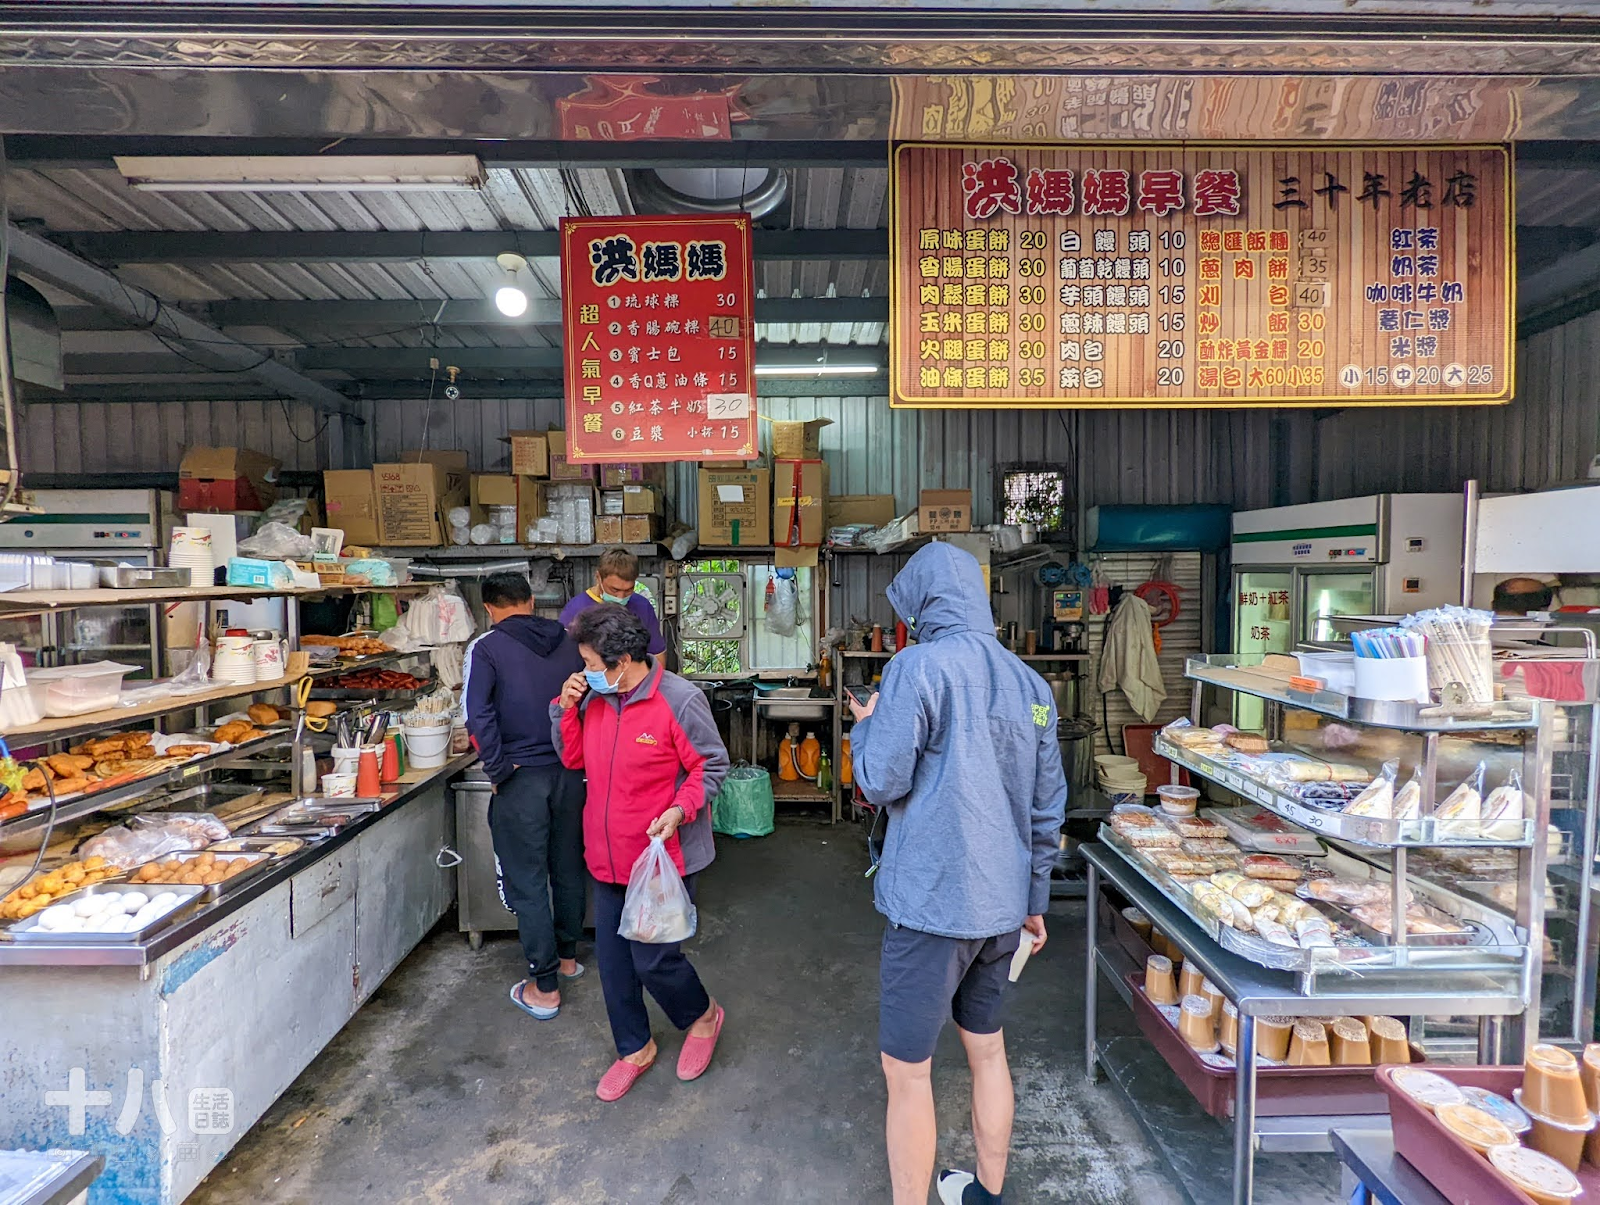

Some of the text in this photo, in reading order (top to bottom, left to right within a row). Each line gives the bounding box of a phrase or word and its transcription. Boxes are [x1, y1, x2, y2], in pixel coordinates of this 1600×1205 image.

[963, 157, 1478, 218] 洪媽媽早餐 三十年老店
[919, 228, 1046, 252] 原味蛋餅 20
[1060, 230, 1185, 253] 白饅頭 10
[1307, 231, 1326, 242] 40
[1392, 228, 1438, 250] 紅茶
[590, 236, 725, 286] 洪媽媽
[919, 256, 1046, 279] 香腸蛋餅 30
[1060, 258, 1185, 280] 葡萄乾饅頭 10
[1310, 259, 1328, 274] 35
[1392, 256, 1438, 277] 奶茶
[716, 293, 736, 307] 30
[919, 284, 1046, 306] 肉鬆蛋餅 30
[1060, 285, 1185, 307] 芋頭饅頭 15
[1200, 285, 1318, 306] 刈包 40
[1366, 283, 1464, 303] 咖啡牛奶
[710, 318, 733, 336] 40
[919, 312, 1046, 334] 玉米蛋餅 30
[1159, 314, 1185, 331] 15
[1200, 314, 1324, 333] 炒飯 30
[1379, 310, 1449, 330] 薏仁漿
[628, 346, 680, 363] 賓士包
[719, 347, 737, 360] 15
[919, 339, 1046, 360] 火腿蛋餅 30
[1060, 340, 1184, 361] 肉包 20
[1199, 340, 1324, 360] 酥炸黃金粿 20
[1392, 337, 1436, 358] 米漿
[580, 304, 603, 433] 超人氣早餐
[919, 366, 1046, 388] 油條蛋餅 35
[1060, 368, 1184, 388] 菜包 20
[1199, 367, 1241, 388] 湯包
[1365, 367, 1387, 384] 15
[1416, 366, 1439, 383] 20
[1468, 366, 1492, 383] 25
[719, 373, 738, 386] 15
[628, 398, 702, 415] 紅茶牛奶
[715, 398, 742, 414] 30
[630, 425, 664, 442] 豆漿
[721, 426, 739, 439] 15
[1251, 626, 1270, 640] 奶茶
[1284, 803, 1296, 816] 45
[1309, 815, 1323, 827] 30
